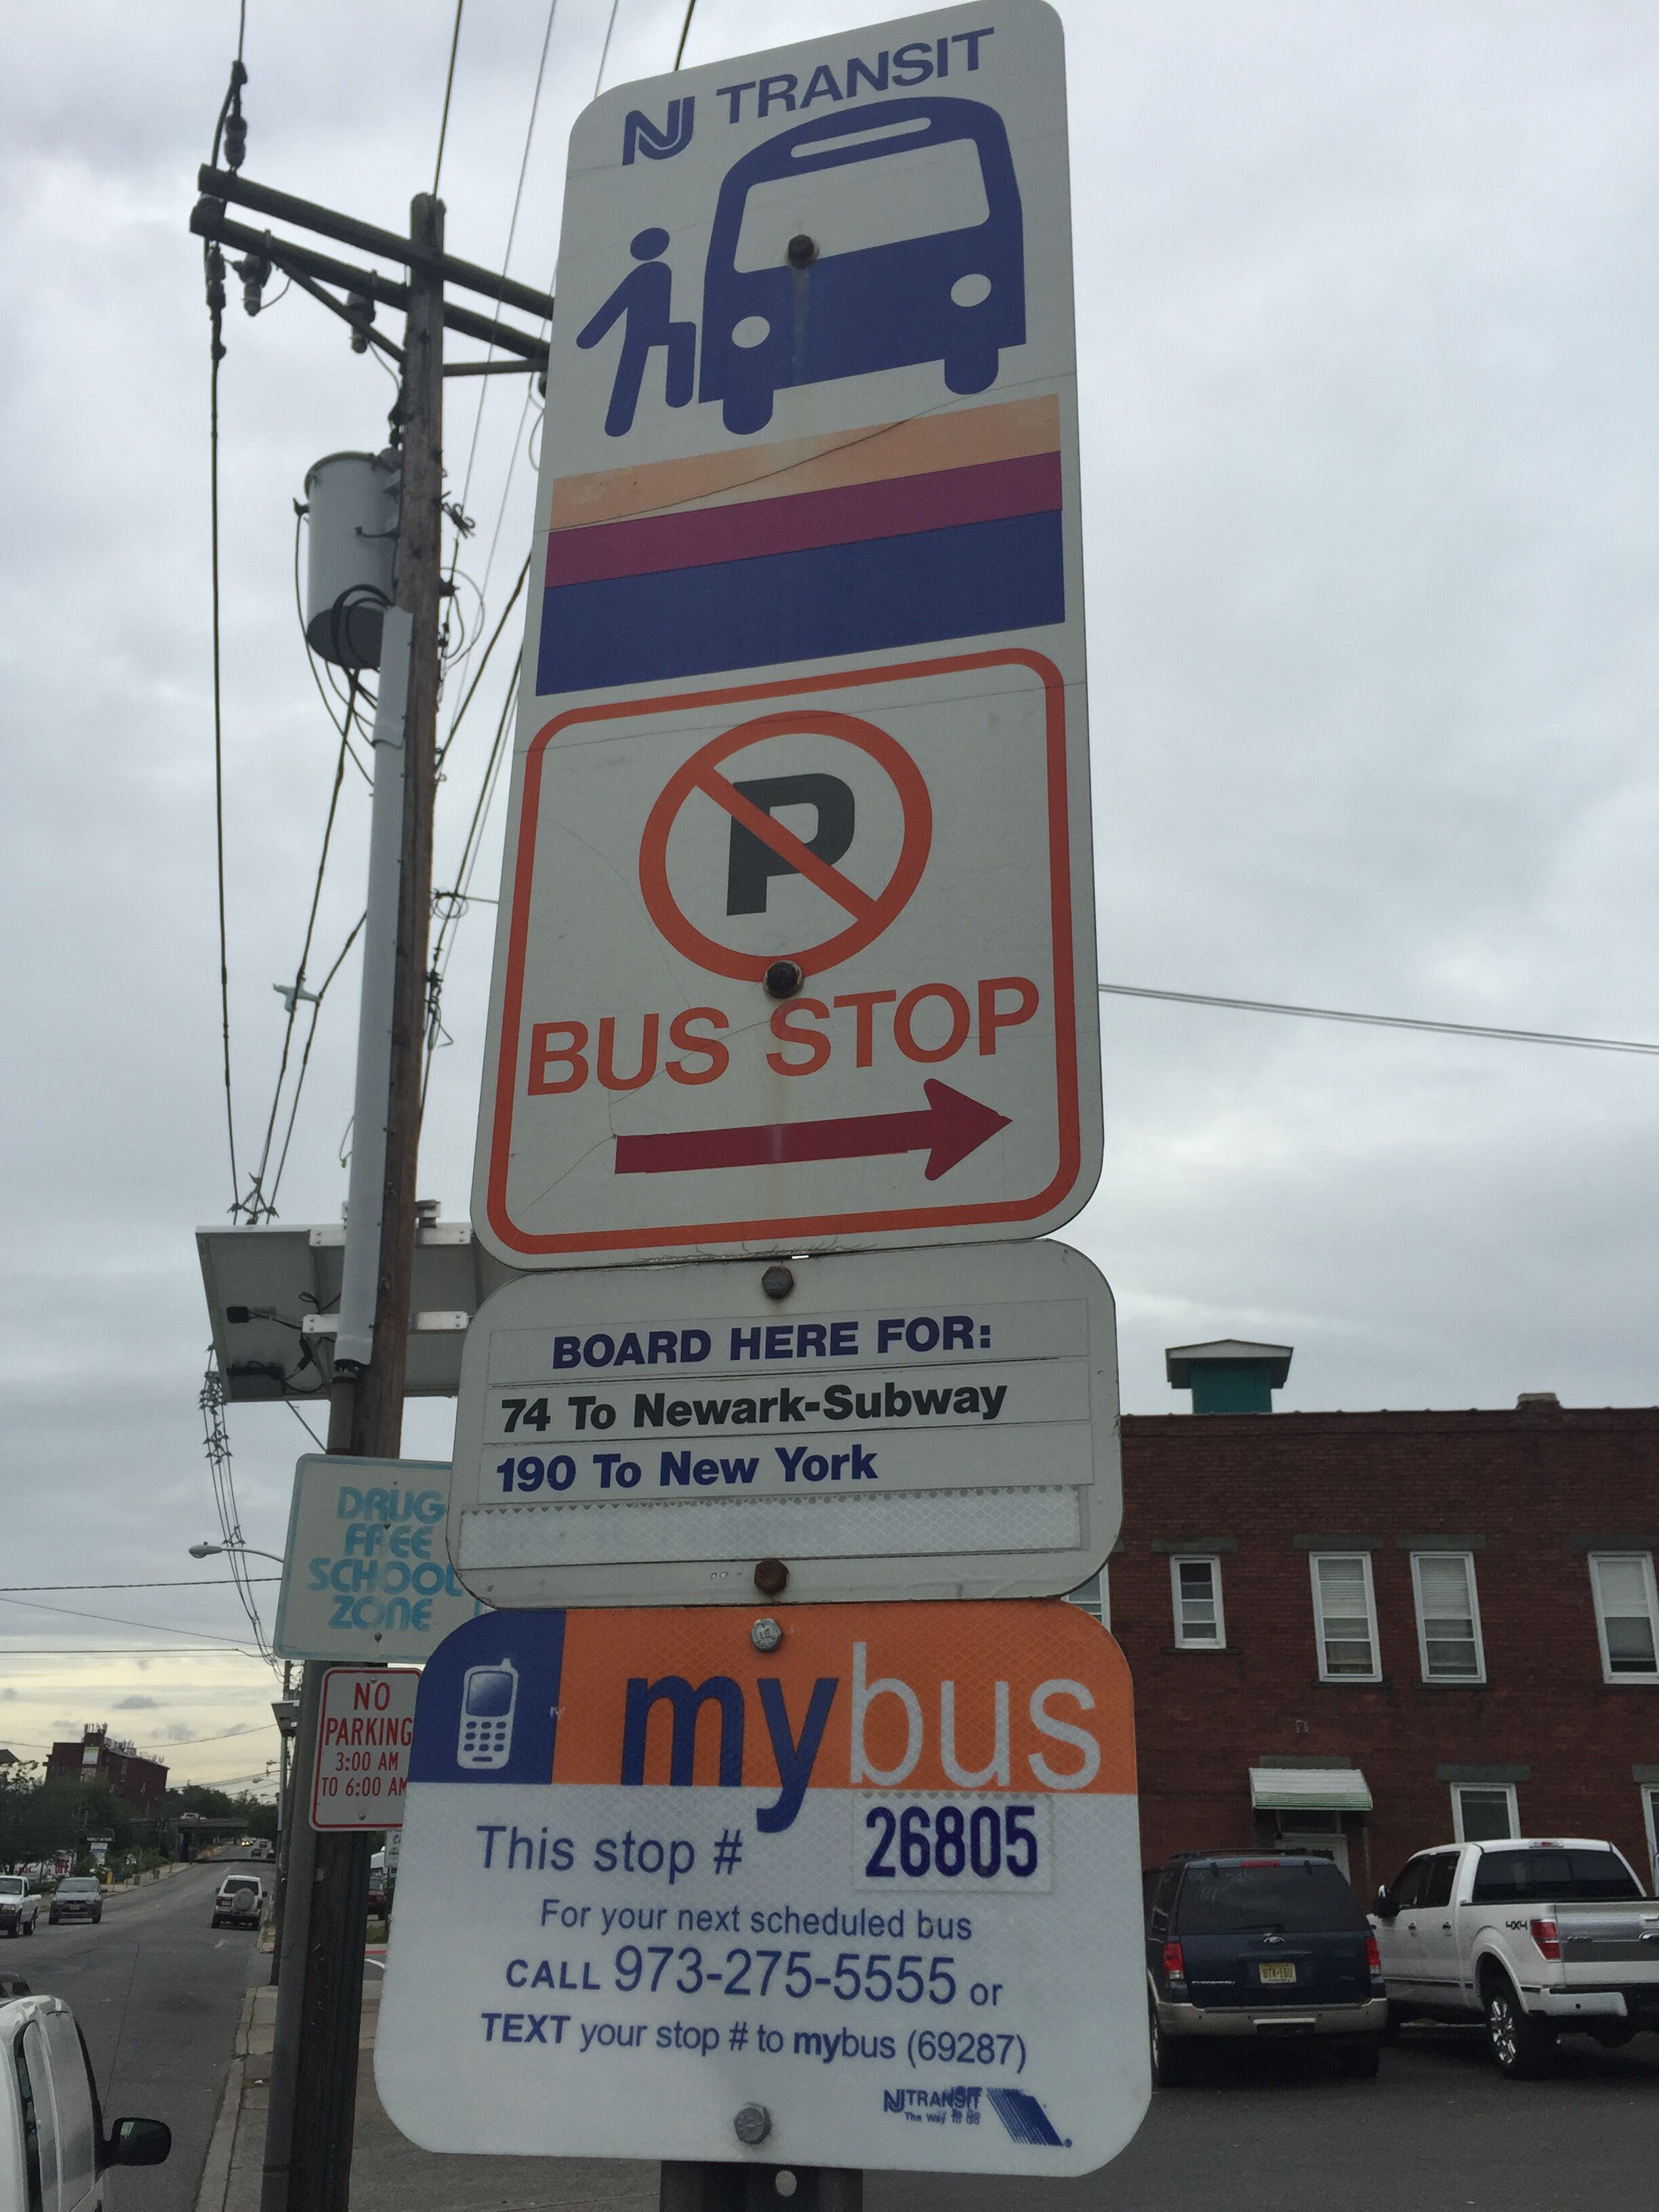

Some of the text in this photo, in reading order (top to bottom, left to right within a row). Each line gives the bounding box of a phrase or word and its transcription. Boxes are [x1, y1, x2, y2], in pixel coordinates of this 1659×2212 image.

[716, 27, 995, 125] TRANSIT
[727, 773, 855, 916] P
[529, 977, 1040, 1095] BUS STOP
[553, 1316, 990, 1369] BOARD HERE FOR:
[501, 1383, 1007, 1433] 74 To Newark-Subway
[497, 1444, 878, 1492] 190 To New York
[337, 1486, 447, 1525] DRUG
[344, 1523, 434, 1559] FREE
[308, 1557, 463, 1597] SCHOOL
[328, 1595, 433, 1631] ZONE
[354, 1683, 390, 1711] NO
[325, 1717, 413, 1746] PARKING
[621, 1641, 1101, 1832] mybus
[335, 1752, 398, 1771] 3:00 AM
[322, 1777, 407, 1797] TO 6:00 AM
[476, 1805, 1037, 1885] This stop # 26805
[541, 1899, 972, 1940] For your next scheduled bus
[506, 1946, 1003, 2006] CALL 973-275-5555 or
[481, 2013, 1026, 2074] TEXT your stop # to mybus (69287)
[904, 2110, 923, 2123] The
[926, 2111, 947, 2125] Way
[905, 2086, 982, 2109] TRANSIT
